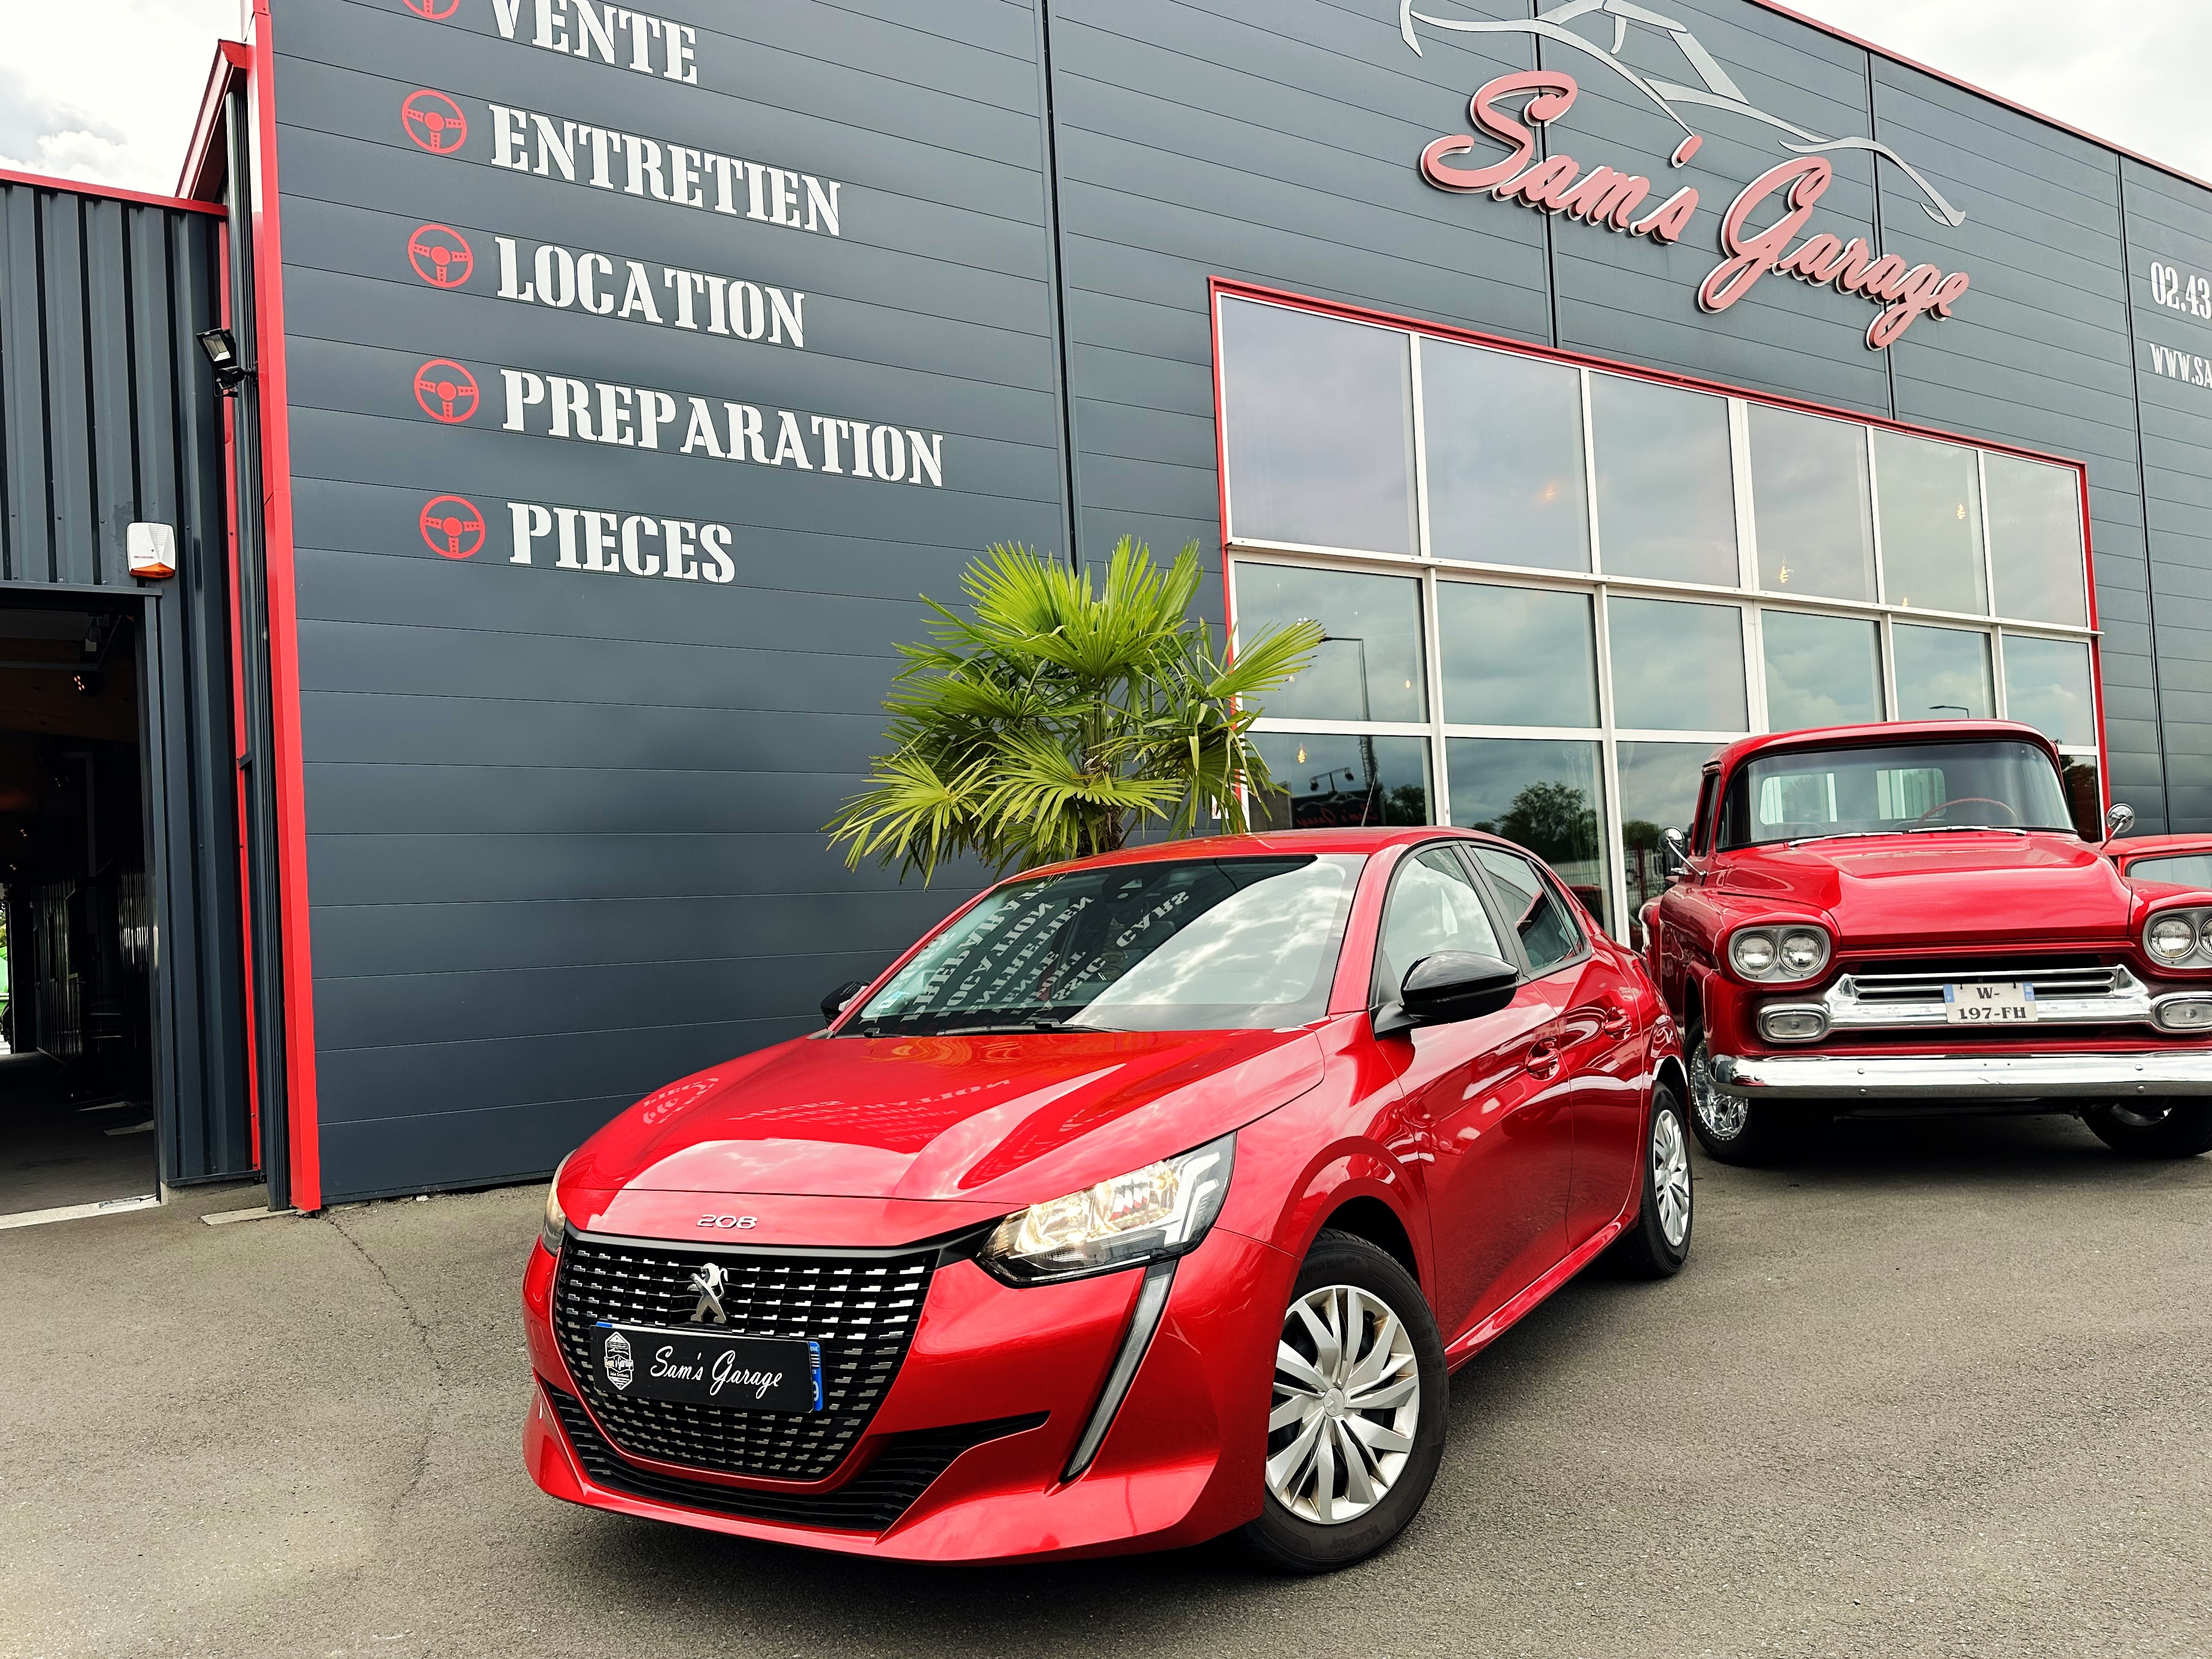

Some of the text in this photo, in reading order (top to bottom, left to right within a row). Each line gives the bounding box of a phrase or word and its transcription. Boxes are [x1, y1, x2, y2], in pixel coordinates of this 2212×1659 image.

[491, 0, 697, 85] VENTE
[488, 104, 841, 237] ENTRETIEN
[1421, 70, 1969, 351] Sam's Garage
[494, 236, 805, 348] LOCATION
[500, 368, 943, 487] PREPARATION
[507, 502, 736, 583] PIECES
[1958, 1007, 2026, 1020] 197-FH
[696, 1214, 758, 1229] 208
[650, 1345, 782, 1399] Sam's Garage
